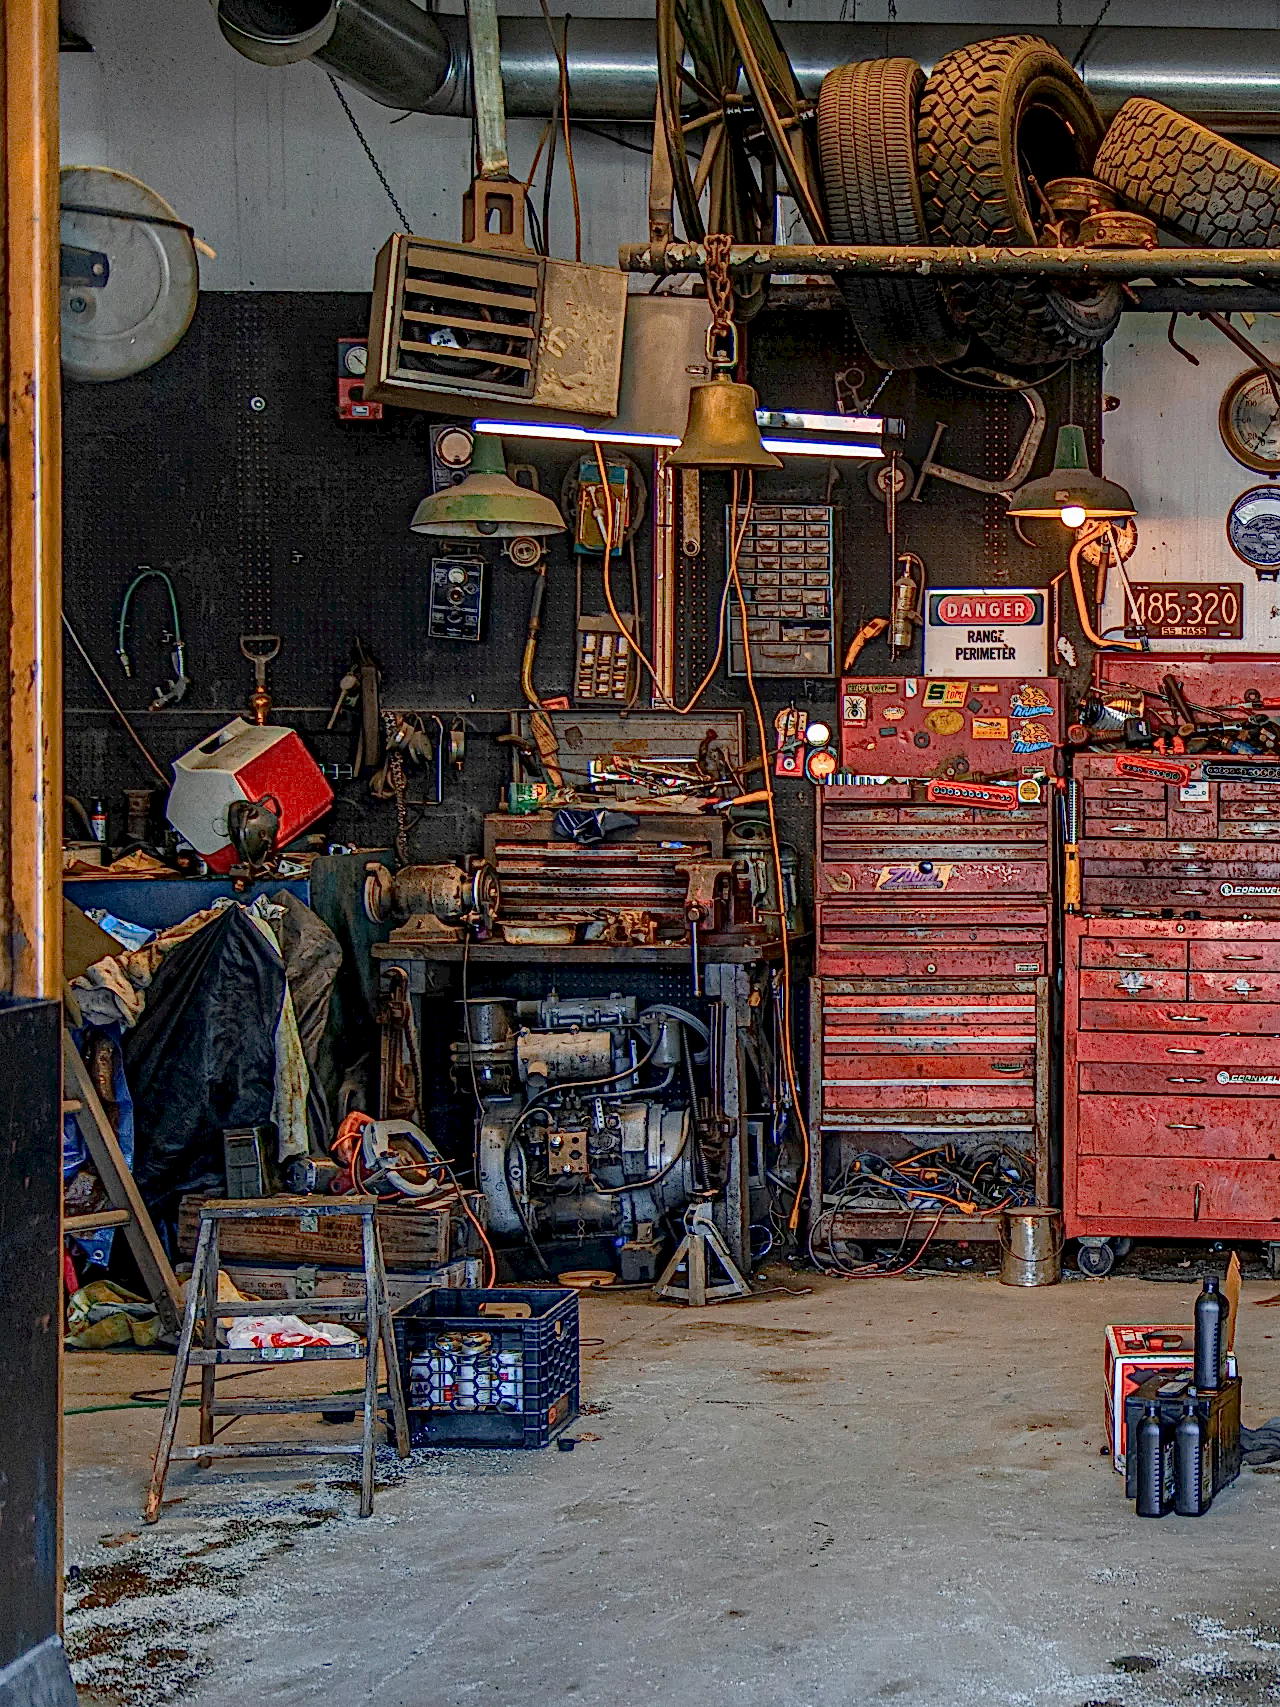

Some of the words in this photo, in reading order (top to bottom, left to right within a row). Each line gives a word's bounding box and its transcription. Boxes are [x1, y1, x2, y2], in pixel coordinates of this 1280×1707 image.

[946, 601, 1026, 618] DANGER
[967, 629, 1005, 644] RANGE
[1181, 627, 1206, 635] MASS
[955, 646, 1016, 661] PERIMETER
